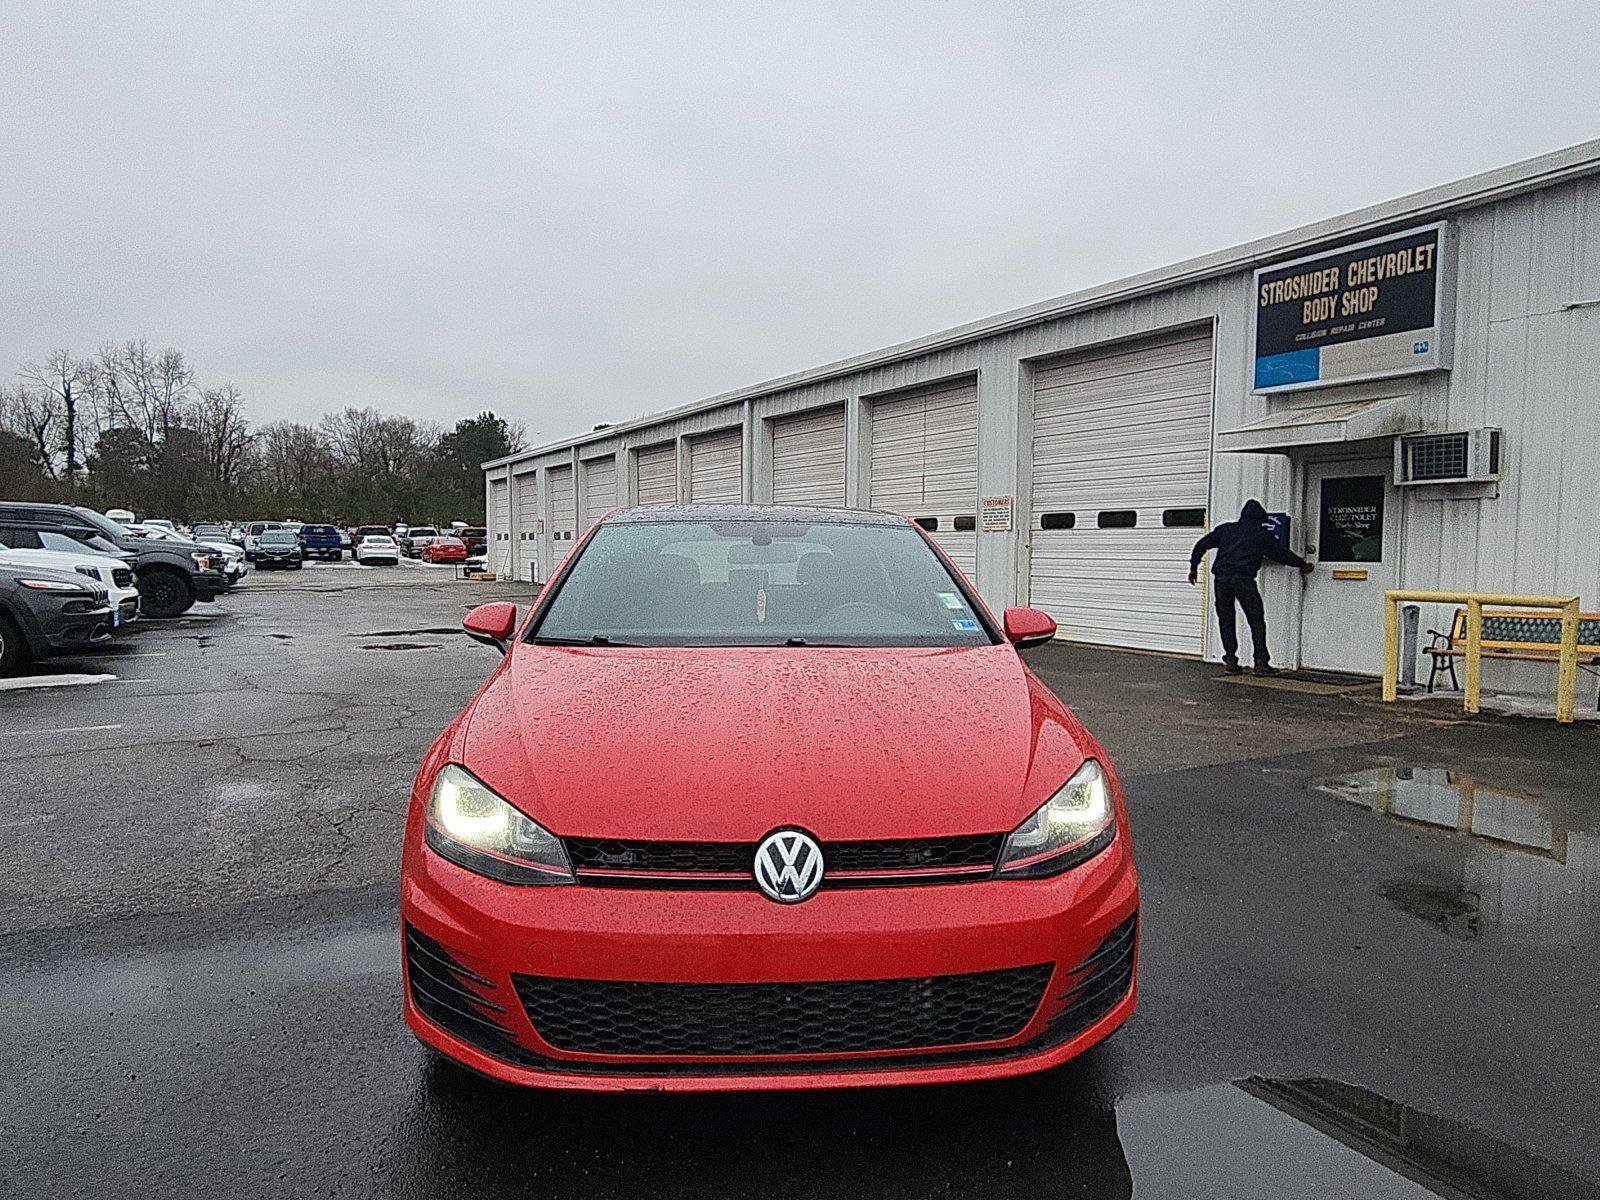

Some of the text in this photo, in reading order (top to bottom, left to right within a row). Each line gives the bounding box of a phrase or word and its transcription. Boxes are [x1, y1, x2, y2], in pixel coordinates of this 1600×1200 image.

[1261, 244, 1435, 307] STROSNIDER CHEVROLET
[1302, 286, 1379, 325] BODY SHOP
[1331, 323, 1355, 336] REPAIR
[1358, 317, 1387, 330] CENTER
